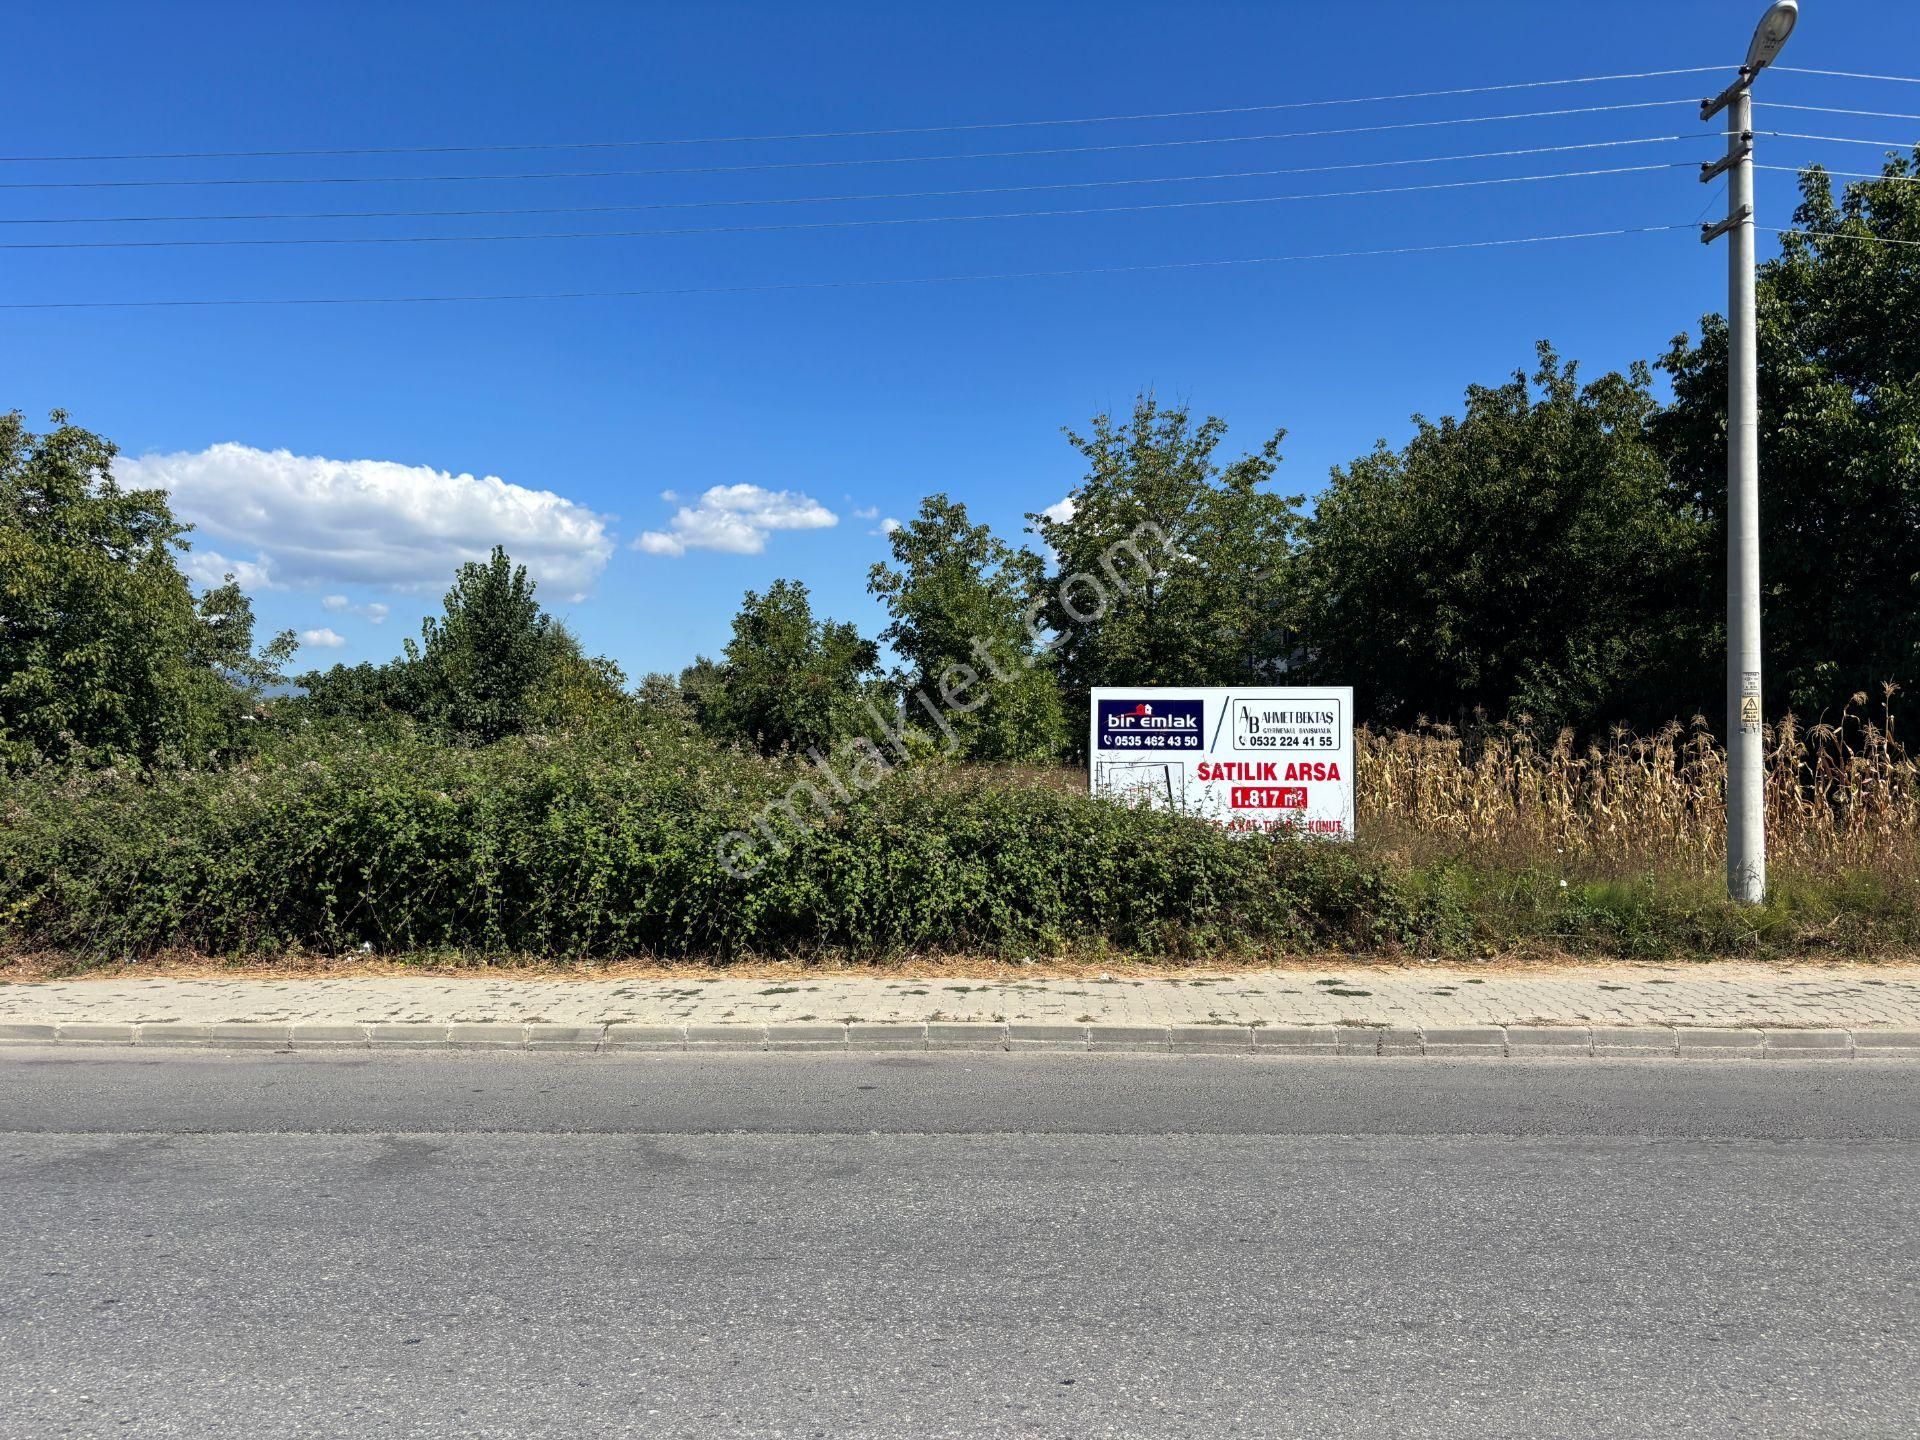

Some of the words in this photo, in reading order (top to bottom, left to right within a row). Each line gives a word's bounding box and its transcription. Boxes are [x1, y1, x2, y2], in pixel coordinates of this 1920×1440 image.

[1108, 714, 1135, 727] bir
[1140, 714, 1197, 727] emlak
[1261, 711, 1294, 723] AHMET
[1296, 711, 1333, 725] BEKTAŞ
[1114, 736, 1141, 746] 0535
[1144, 736, 1165, 746] 462
[1167, 736, 1181, 746] 43
[1184, 736, 1198, 746] 50
[1250, 736, 1276, 746] 0532
[1279, 736, 1299, 746] 224
[1302, 736, 1315, 746] 41
[1319, 736, 1333, 746] 55
[1197, 762, 1278, 781] SATILIK
[1284, 762, 1341, 781] ARSA
[1235, 789, 1280, 807] 1.817
[1308, 820, 1342, 833] KONUT
